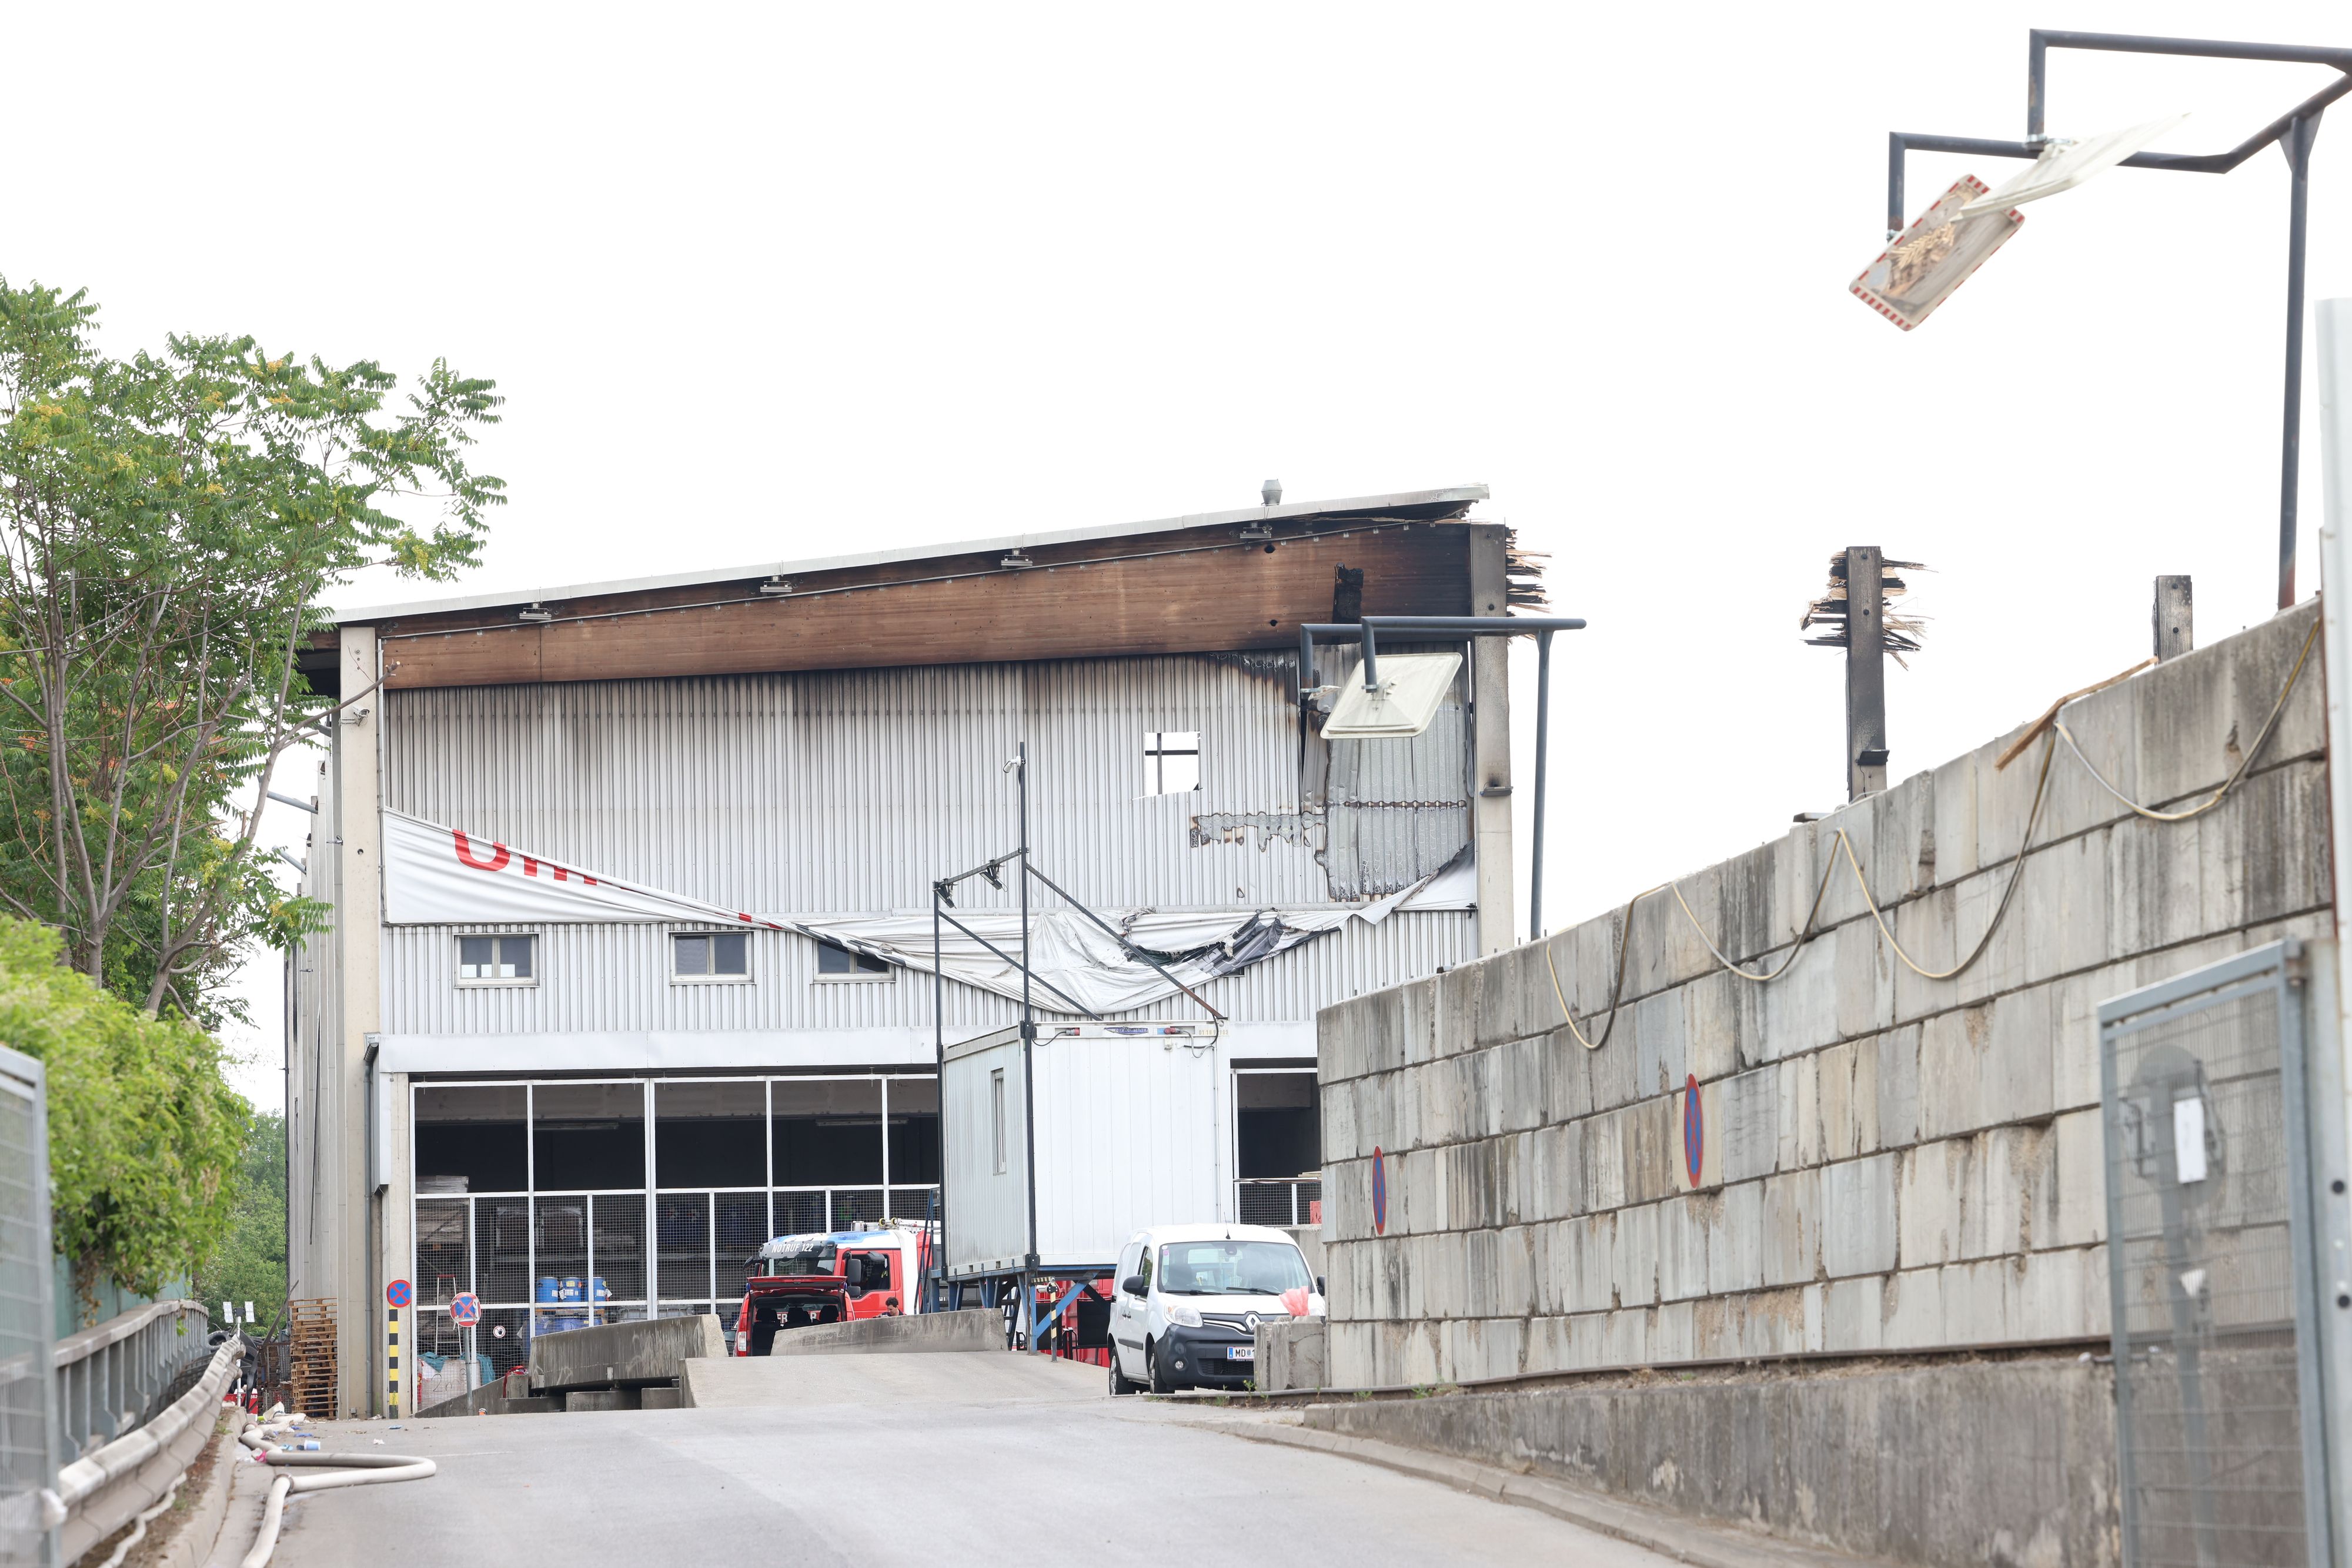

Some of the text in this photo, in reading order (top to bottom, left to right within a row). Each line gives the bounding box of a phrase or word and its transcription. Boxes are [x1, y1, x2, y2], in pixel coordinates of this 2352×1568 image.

[771, 1243, 814, 1253] NOTRUF 122
[1235, 1349, 1246, 1357] MD
